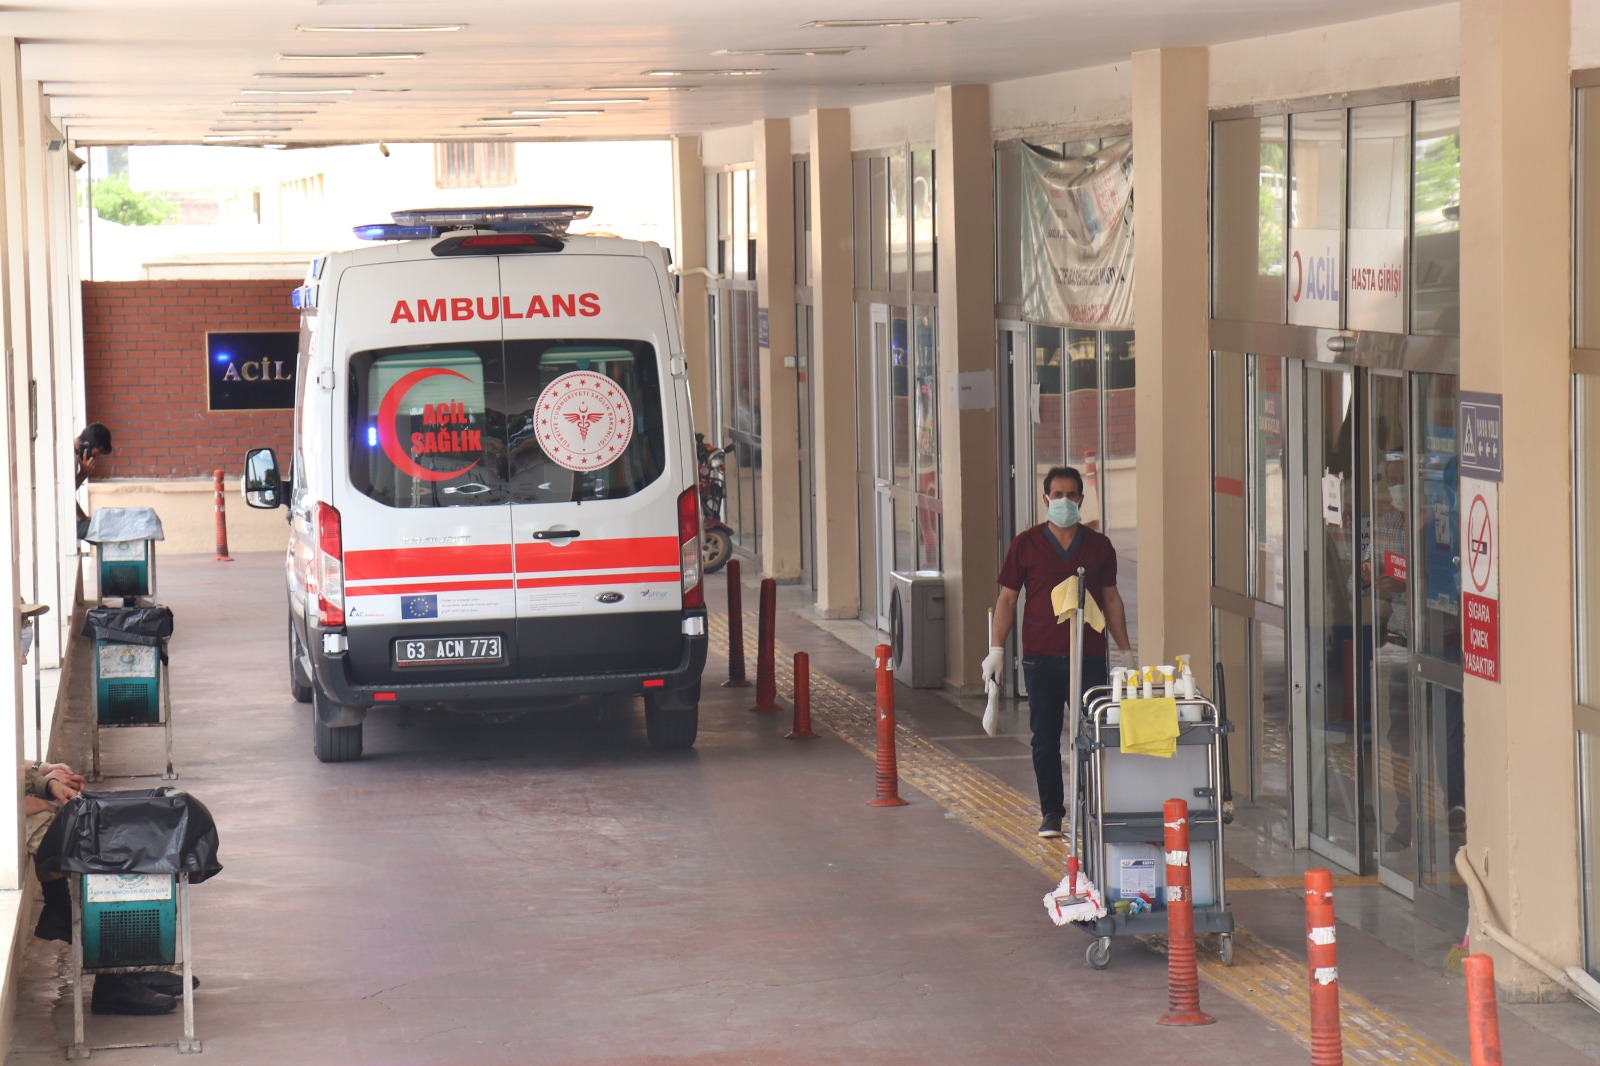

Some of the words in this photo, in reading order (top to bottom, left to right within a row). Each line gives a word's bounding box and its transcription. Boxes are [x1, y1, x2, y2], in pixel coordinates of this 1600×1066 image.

[1306, 247, 1338, 302] ACİL
[1352, 268, 1376, 291] HASTA
[1378, 264, 1402, 298] GİRİŞİ
[390, 292, 601, 324] AMBULANS
[222, 356, 292, 382] ACİL
[422, 399, 468, 425] ACİL
[555, 390, 590, 421] CUMHURİYETİ
[591, 393, 611, 411] SAĞLIK
[410, 427, 484, 454] SAĞLIK
[553, 422, 571, 448] TÜRKİYE
[597, 412, 614, 447] BAKANLIĞI
[1476, 418, 1488, 438] YAYA
[1487, 419, 1499, 440] YOLU
[1468, 597, 1490, 623] SİGARA
[406, 641, 426, 659] 63
[436, 640, 464, 658] ACN
[470, 639, 498, 656] 773
[1470, 623, 1489, 650] İÇMEK
[1464, 652, 1495, 678] YASAKTIR!
